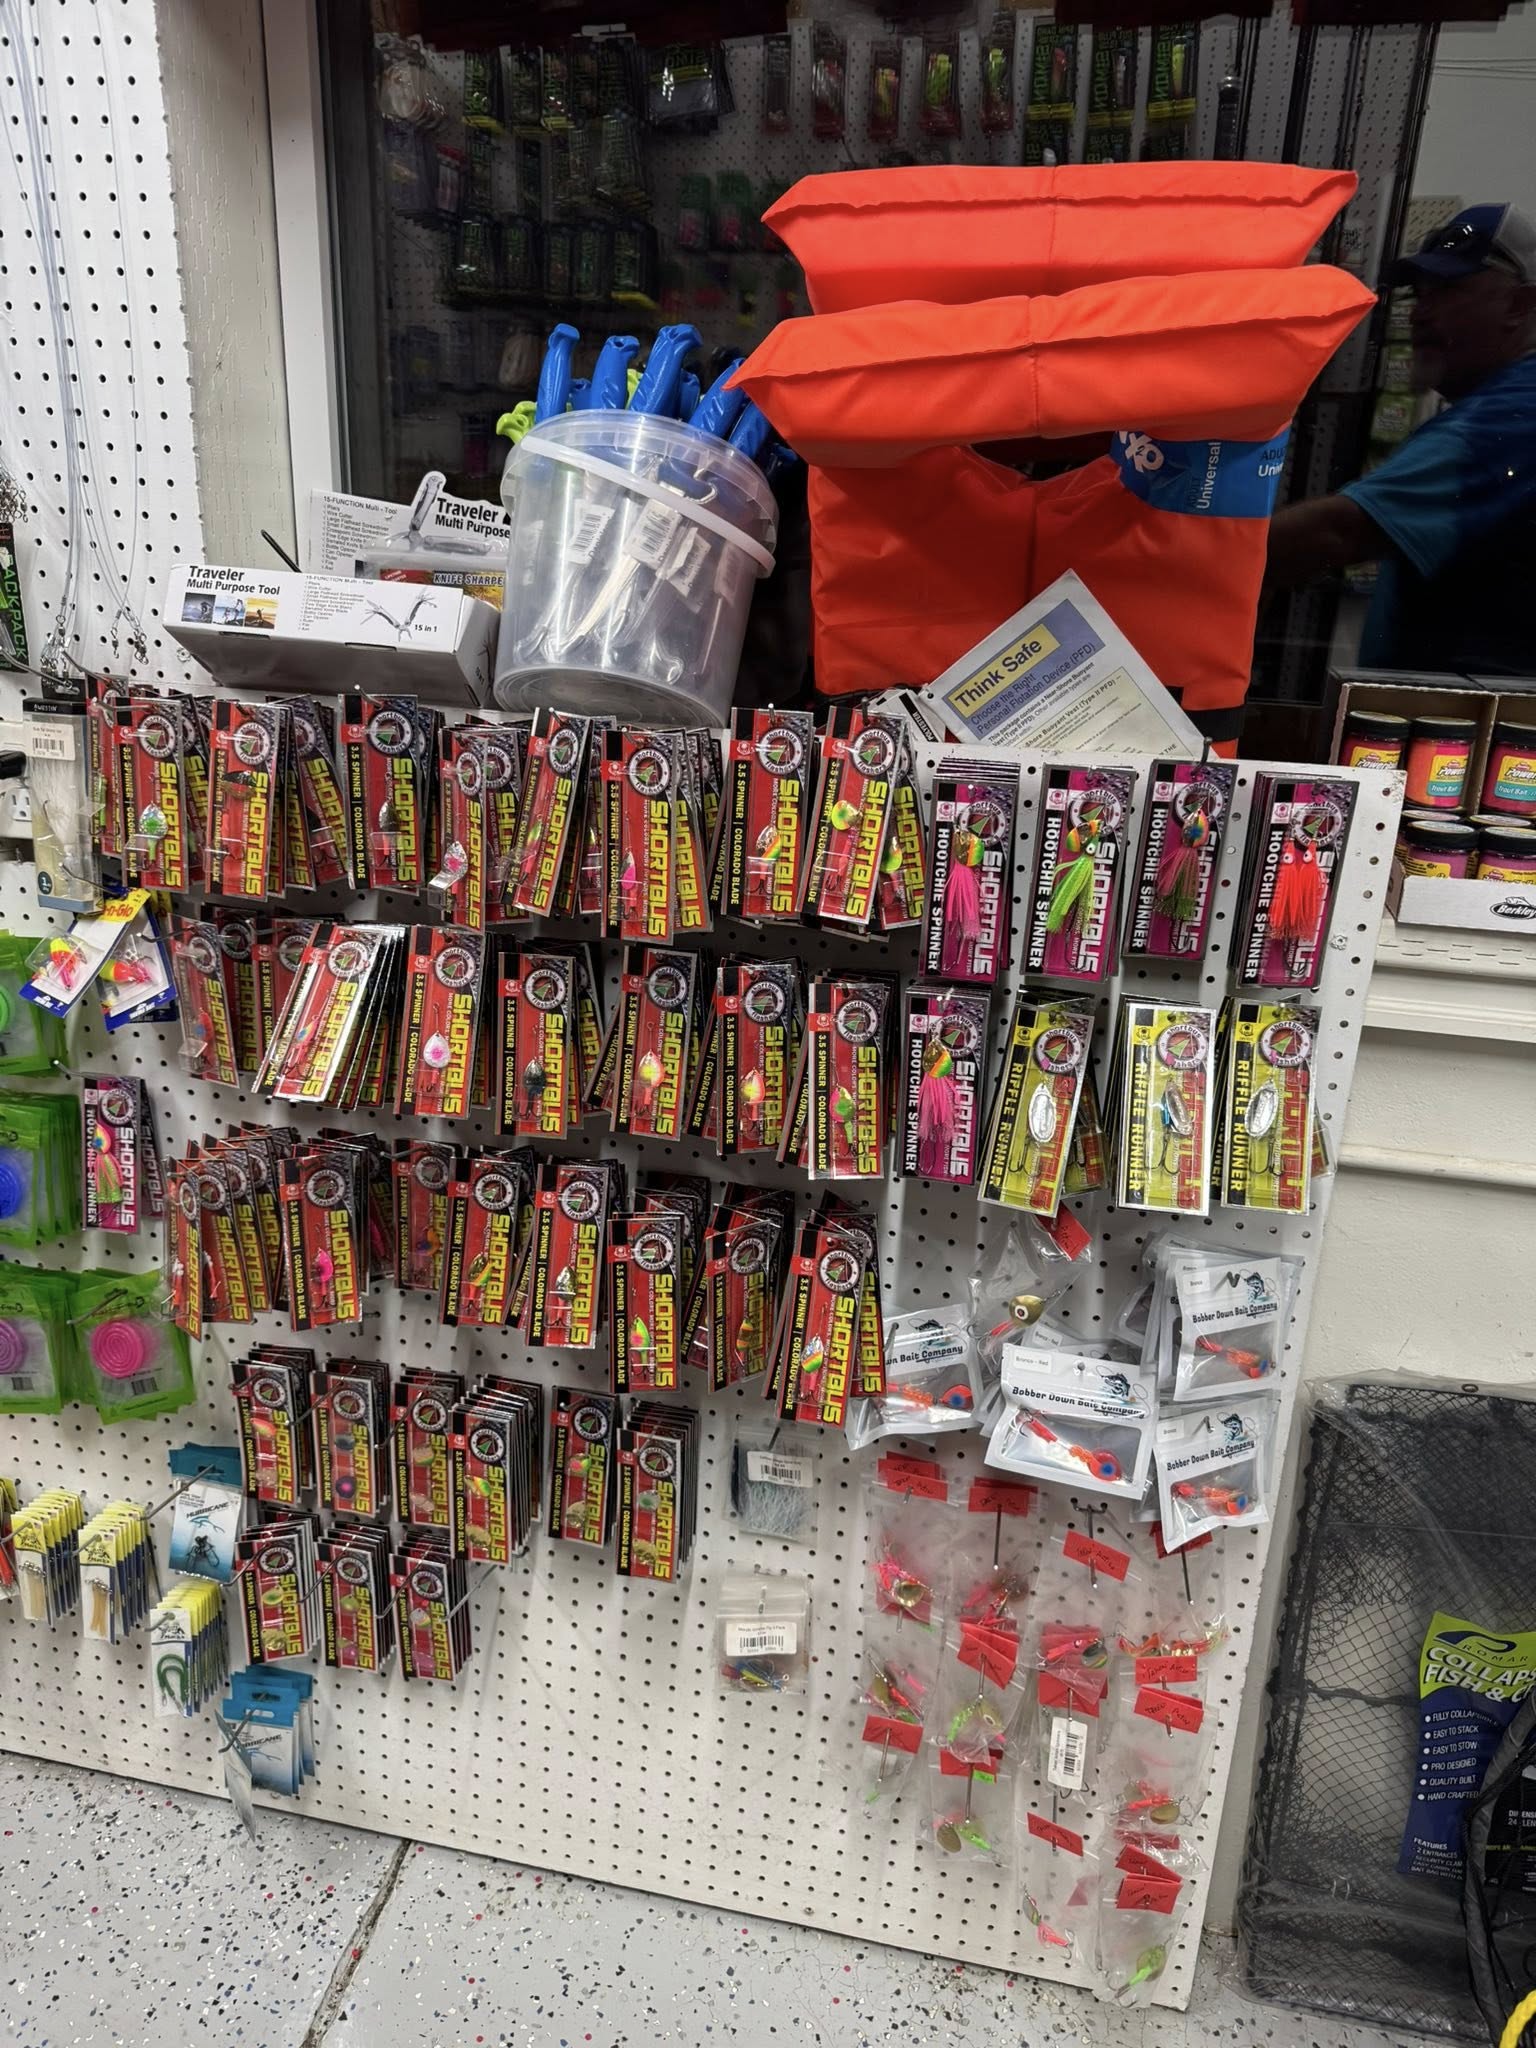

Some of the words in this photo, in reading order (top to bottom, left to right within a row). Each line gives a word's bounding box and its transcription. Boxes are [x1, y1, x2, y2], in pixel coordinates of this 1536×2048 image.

[1196, 441, 1222, 509] Universal
[435, 514, 463, 530] Multi
[466, 519, 510, 540] Purpose
[437, 498, 498, 523] Traveler
[186, 578, 214, 591] Multi
[215, 580, 256, 596] Purpose
[257, 584, 281, 596] Tool
[189, 566, 245, 582] Traveler
[433, 573, 462, 585] KNIFE
[954, 669, 1005, 709] Think
[1001, 637, 1043, 673] Safe
[970, 700, 1001, 726] Choose
[999, 690, 1015, 703] the
[1012, 673, 1037, 695] Right
[977, 706, 1012, 735] Personal
[1009, 681, 1045, 710] Flotation
[1041, 660, 1071, 685] Device
[1070, 642, 1096, 667] (PFD)
[765, 728, 798, 744] shortbus
[861, 727, 892, 745] shortbus
[913, 711, 935, 742] POLYESTER
[734, 777, 746, 819] SPINNER
[737, 763, 747, 776] 3.5
[244, 771, 269, 895] SHORTBUS
[393, 757, 417, 882] SHORTBUS
[533, 778, 571, 907] SHORTBUS
[731, 827, 743, 876] COLORADO
[772, 779, 800, 913] SHORTBUS
[845, 779, 889, 917] SHORTBUS
[893, 785, 926, 920] SHORTBUS
[1141, 808, 1168, 883] HOOTCHIE
[467, 800, 483, 928] SHORTBUS
[647, 800, 670, 937] SHORTBUS
[731, 877, 741, 905] BLADE
[932, 827, 951, 904] HOOTCHIE
[1038, 817, 1062, 899] HOOTCHIE
[1257, 831, 1284, 908] HOOTCHIE
[927, 906, 944, 971] SPINNER
[1028, 900, 1050, 968] SPINNER
[1132, 886, 1154, 948] SPINNER
[1243, 911, 1268, 979] SPINNER
[750, 981, 780, 996] shortbus
[842, 1000, 873, 1016] shortbus
[207, 978, 235, 1085] SHORTBUS
[302, 981, 357, 1097] SHORTBUS
[442, 993, 474, 1115] SHORTBUS
[1045, 1028, 1078, 1044] shortbus
[1166, 1025, 1203, 1040] shortbus
[1269, 1021, 1307, 1036] shortbus
[542, 1012, 565, 1133] SHORTBUS
[655, 1012, 685, 1136] SHORTBUS
[762, 1025, 785, 1146] SHORTBUS
[907, 1039, 924, 1108] HOOTCHIE
[1000, 1062, 1024, 1117] RIFFLE
[1132, 1061, 1149, 1118] RIFFLE
[1234, 1059, 1251, 1114] RIFFLE
[855, 1046, 878, 1174] SHORTBUS
[905, 1111, 921, 1171] SPINNER
[120, 1127, 136, 1227] SHORTBUS
[566, 1180, 596, 1194] shortbus
[987, 1121, 1013, 1187] RUNNER
[1128, 1123, 1144, 1191] RUNNER
[1229, 1121, 1249, 1191] RUNNER
[216, 1215, 249, 1321] SHORTBUS
[329, 1209, 355, 1319] SHORTBUS
[483, 1213, 511, 1325] SHORTBUS
[639, 1232, 668, 1247] shortbus
[826, 1251, 855, 1266] shortbus
[186, 1226, 199, 1335] SHORTBUS
[570, 1223, 599, 1345] SHORTBUS
[1191, 1310, 1216, 1324] Bobber
[1216, 1307, 1235, 1320] Down
[1234, 1304, 1249, 1316] Bait
[1249, 1301, 1279, 1315] Company
[655, 1273, 673, 1388] SHORTBUS
[822, 1296, 856, 1424] SHORTBUS
[900, 1350, 921, 1363] Bait
[921, 1345, 964, 1361] Company
[1011, 1386, 1047, 1402] Bobber
[1048, 1393, 1076, 1407] Down
[1077, 1397, 1099, 1411] Bait
[272, 1409, 292, 1503] SHORTBUS
[353, 1424, 371, 1515] SHORTBUS
[431, 1434, 449, 1525] SHORTBUS
[1166, 1458, 1190, 1472] Bobber
[1191, 1453, 1210, 1464] Down
[1210, 1448, 1225, 1459] Bait
[1225, 1440, 1256, 1454] Company
[185, 1500, 230, 1518] HURRICANE
[488, 1466, 506, 1562] SHORTBUS
[583, 1443, 606, 1544] SHORTBUS
[653, 1481, 675, 1580] SHORTBUS
[279, 1573, 303, 1656] SHORTBUS
[355, 1585, 374, 1669] SHORTBUS
[1424, 1664, 1481, 1695] FISH
[1485, 1687, 1505, 1702] &
[1462, 1643, 1529, 1663] ROMAR
[1431, 1743, 1448, 1755] EASY
[1449, 1742, 1458, 1753] TO
[1458, 1740, 1478, 1752] STOW
[1432, 1710, 1449, 1723] FULLY
[1432, 1728, 1448, 1739] EASY
[1448, 1727, 1458, 1738] TO
[1458, 1725, 1480, 1737] STACK
[1427, 1791, 1446, 1801] HAND
[1447, 1790, 1480, 1801] CRAFTED
[1429, 1776, 1457, 1787] QUALITY
[1459, 1774, 1477, 1784] BUILT
[1430, 1762, 1444, 1772] PRO
[1444, 1757, 1477, 1771] DESIGNED
[1413, 1837, 1448, 1851] FEATURES
[1421, 1848, 1459, 1860] ENTRANCES
[1507, 1817, 1519, 1826] 24
